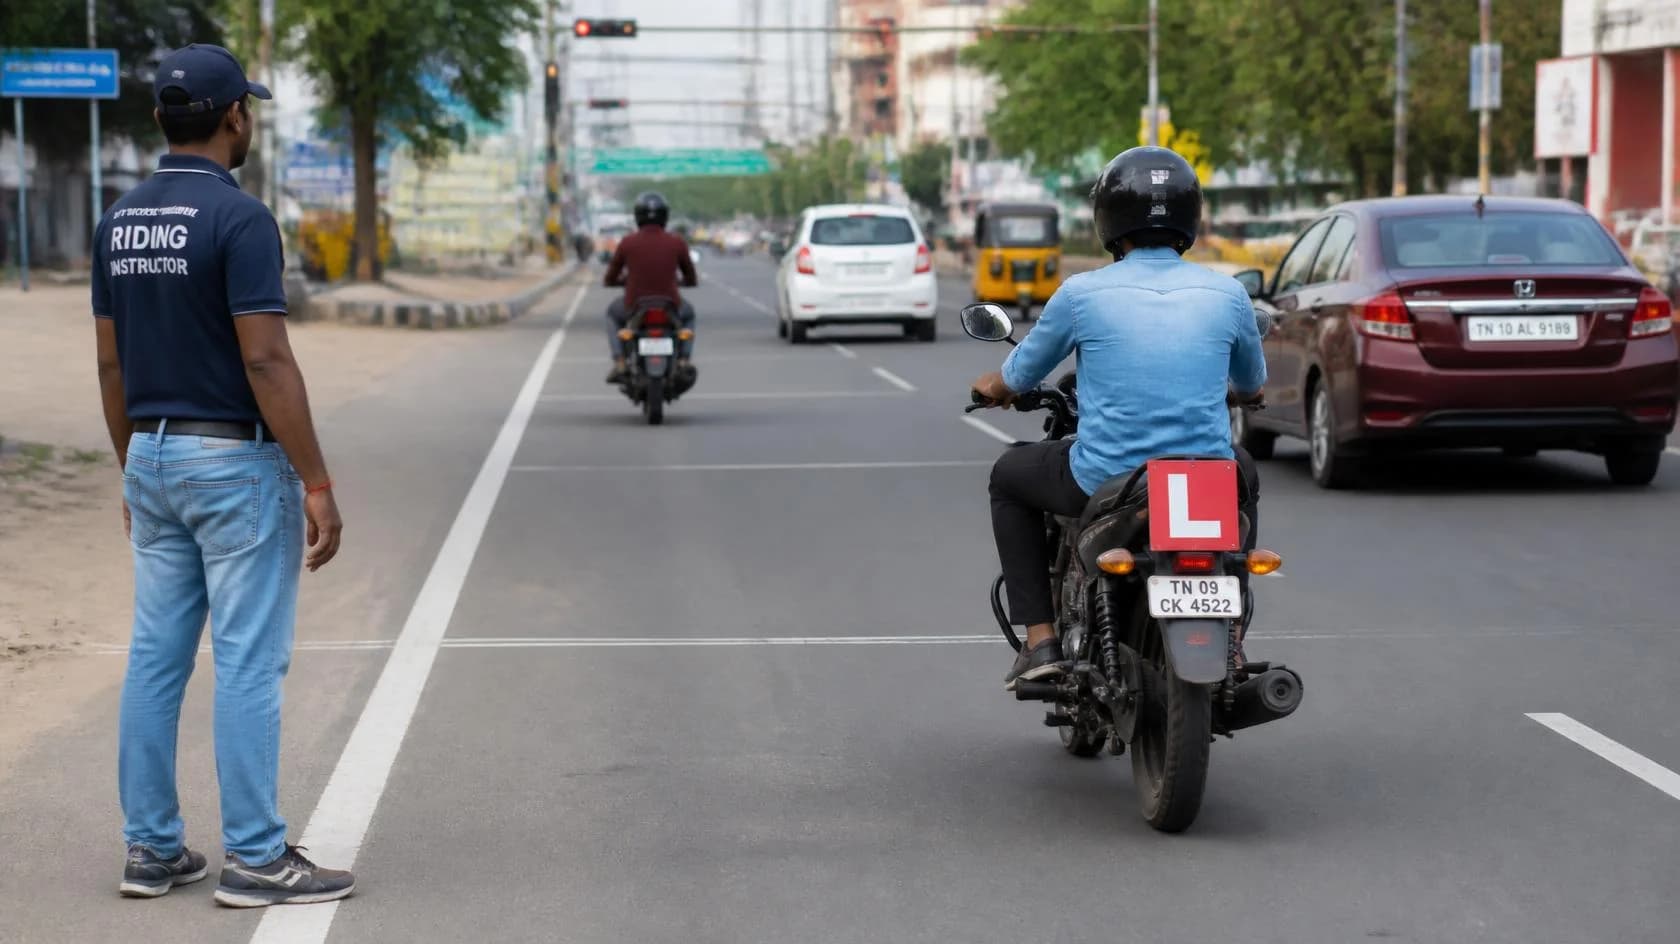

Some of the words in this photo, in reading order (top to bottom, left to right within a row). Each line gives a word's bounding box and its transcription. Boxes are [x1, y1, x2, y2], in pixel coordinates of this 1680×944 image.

[111, 224, 188, 252] RIDING
[1476, 322, 1494, 335] TN
[1498, 322, 1513, 335] 10
[1517, 321, 1534, 335] AL
[1168, 474, 1221, 538] L
[1170, 580, 1193, 595] TN
[1199, 580, 1219, 595] 09
[1160, 599, 1183, 613] CK
[1190, 599, 1232, 613] 4522
